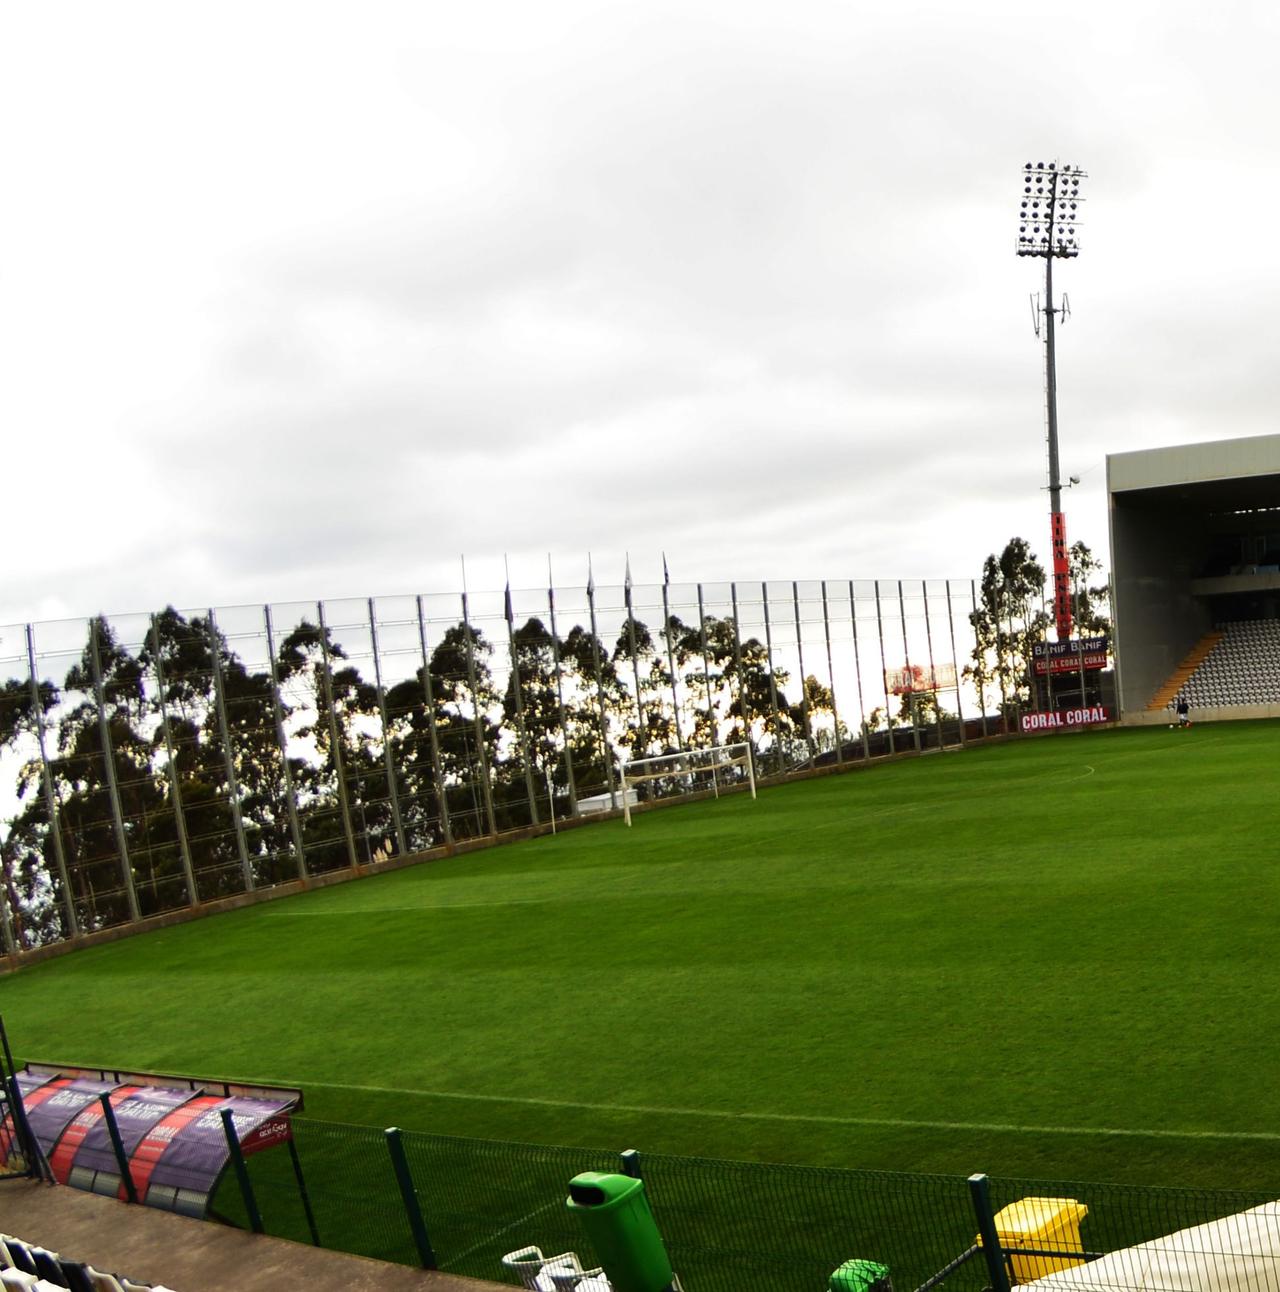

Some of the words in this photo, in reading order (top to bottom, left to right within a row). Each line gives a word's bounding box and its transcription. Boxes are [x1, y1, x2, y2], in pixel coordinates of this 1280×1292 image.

[1036, 661, 1059, 670] COAL
[1084, 655, 1106, 665] CORAL
[1022, 712, 1064, 729] CORAL
[1066, 707, 1107, 724] CORAL
